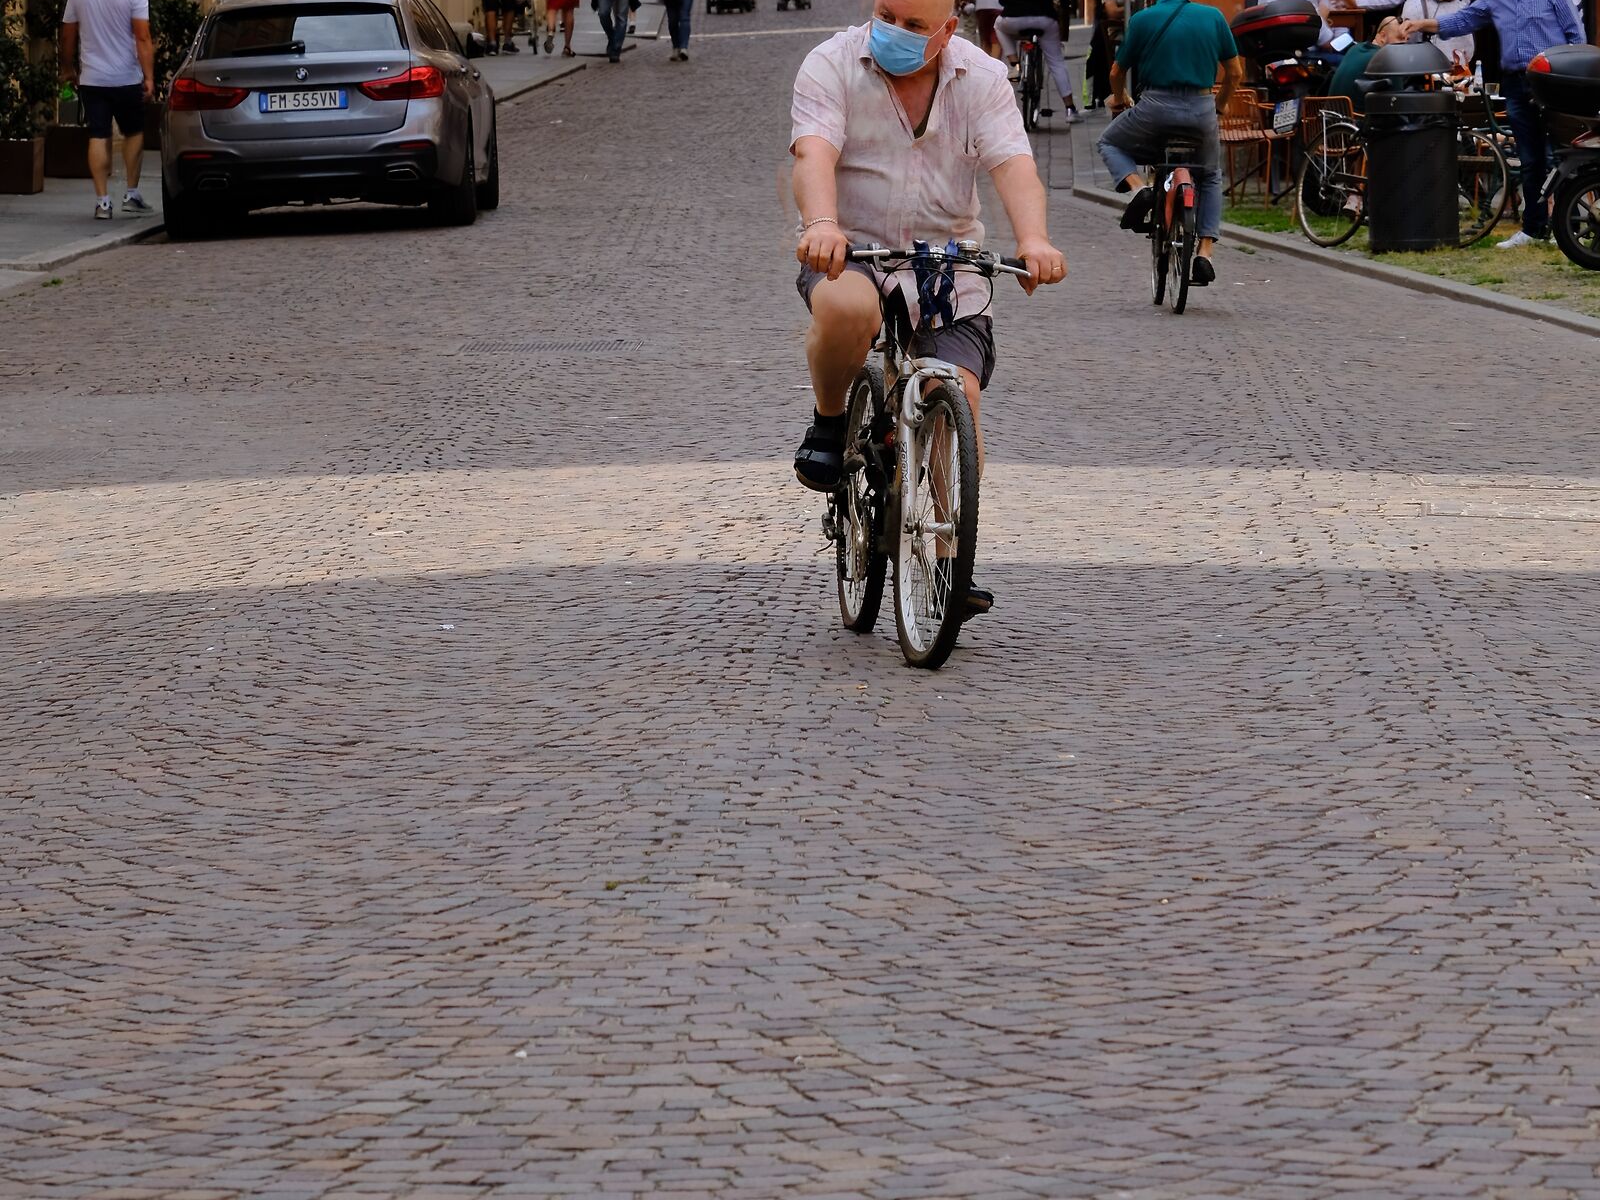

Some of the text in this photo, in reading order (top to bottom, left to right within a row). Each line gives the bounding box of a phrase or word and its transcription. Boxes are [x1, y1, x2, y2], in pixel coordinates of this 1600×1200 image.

[269, 91, 337, 109] FM 555VN
[900, 441, 909, 483] ZOOM
